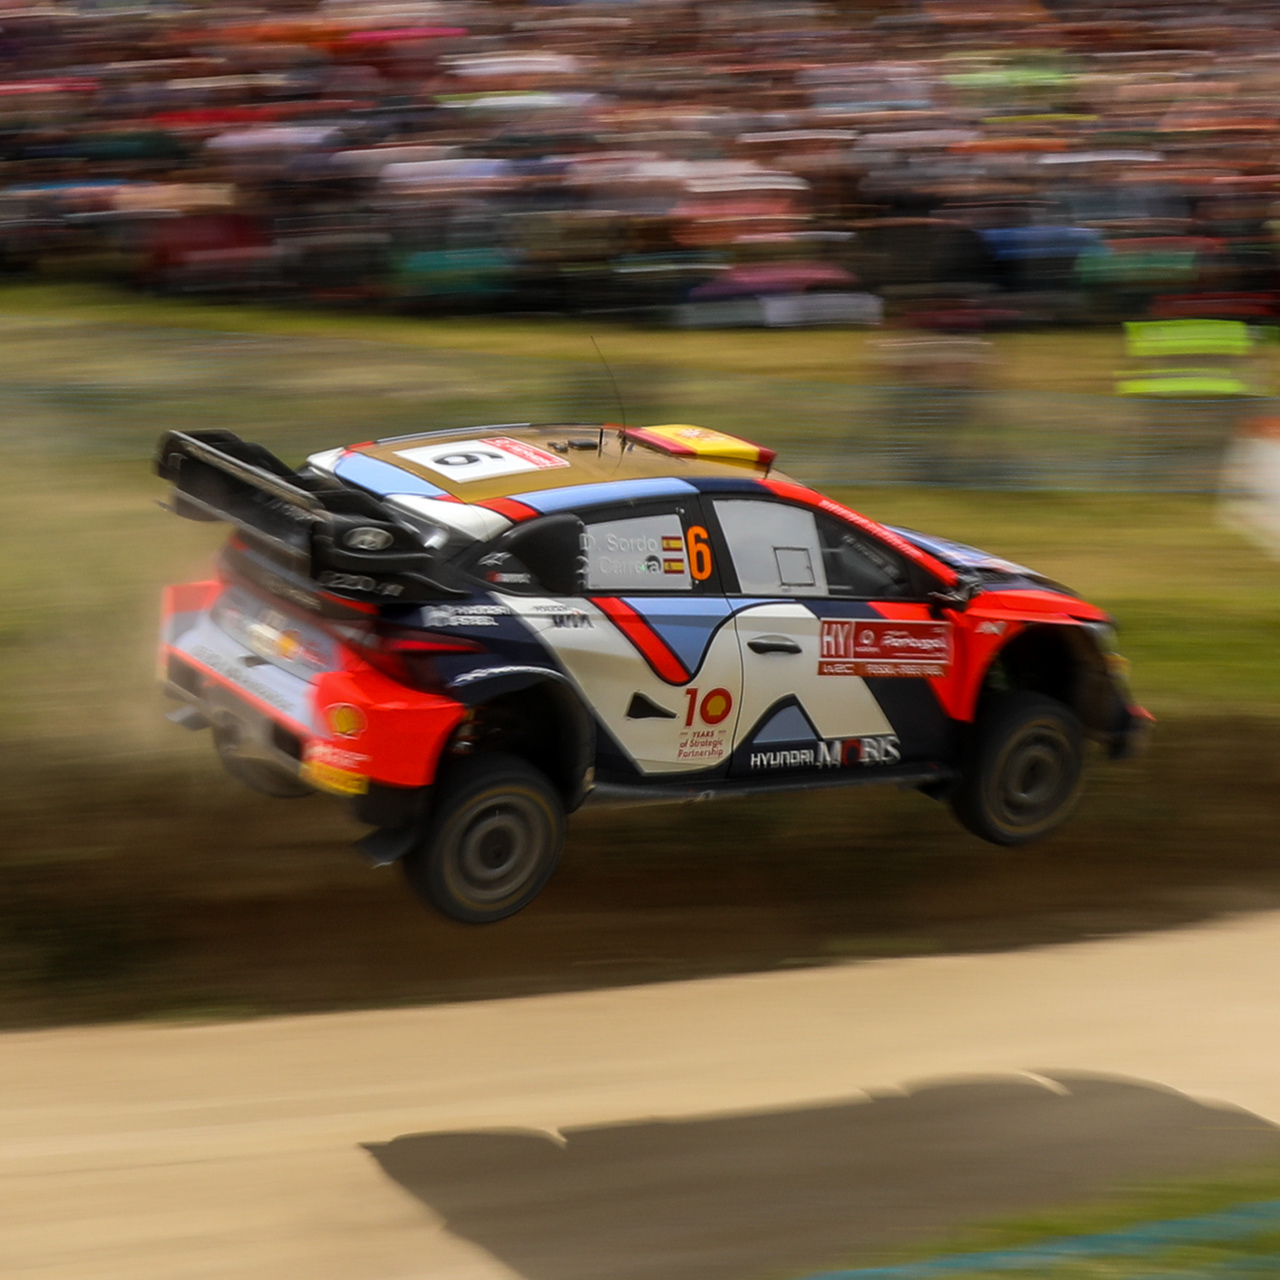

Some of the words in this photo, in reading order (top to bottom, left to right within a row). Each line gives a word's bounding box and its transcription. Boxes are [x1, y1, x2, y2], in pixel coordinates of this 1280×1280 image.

[431, 450, 505, 467] 6
[604, 533, 658, 552] Sordo
[686, 525, 713, 581] 6
[599, 556, 662, 575] Carrera
[822, 622, 850, 657] HY
[684, 687, 733, 725] 10
[679, 738, 689, 748] of
[689, 738, 724, 749] Strategic
[692, 730, 716, 738] YEARS
[677, 747, 724, 759] Partnership
[750, 749, 815, 769] HYUNDAI
[815, 736, 902, 769] MOBIS
